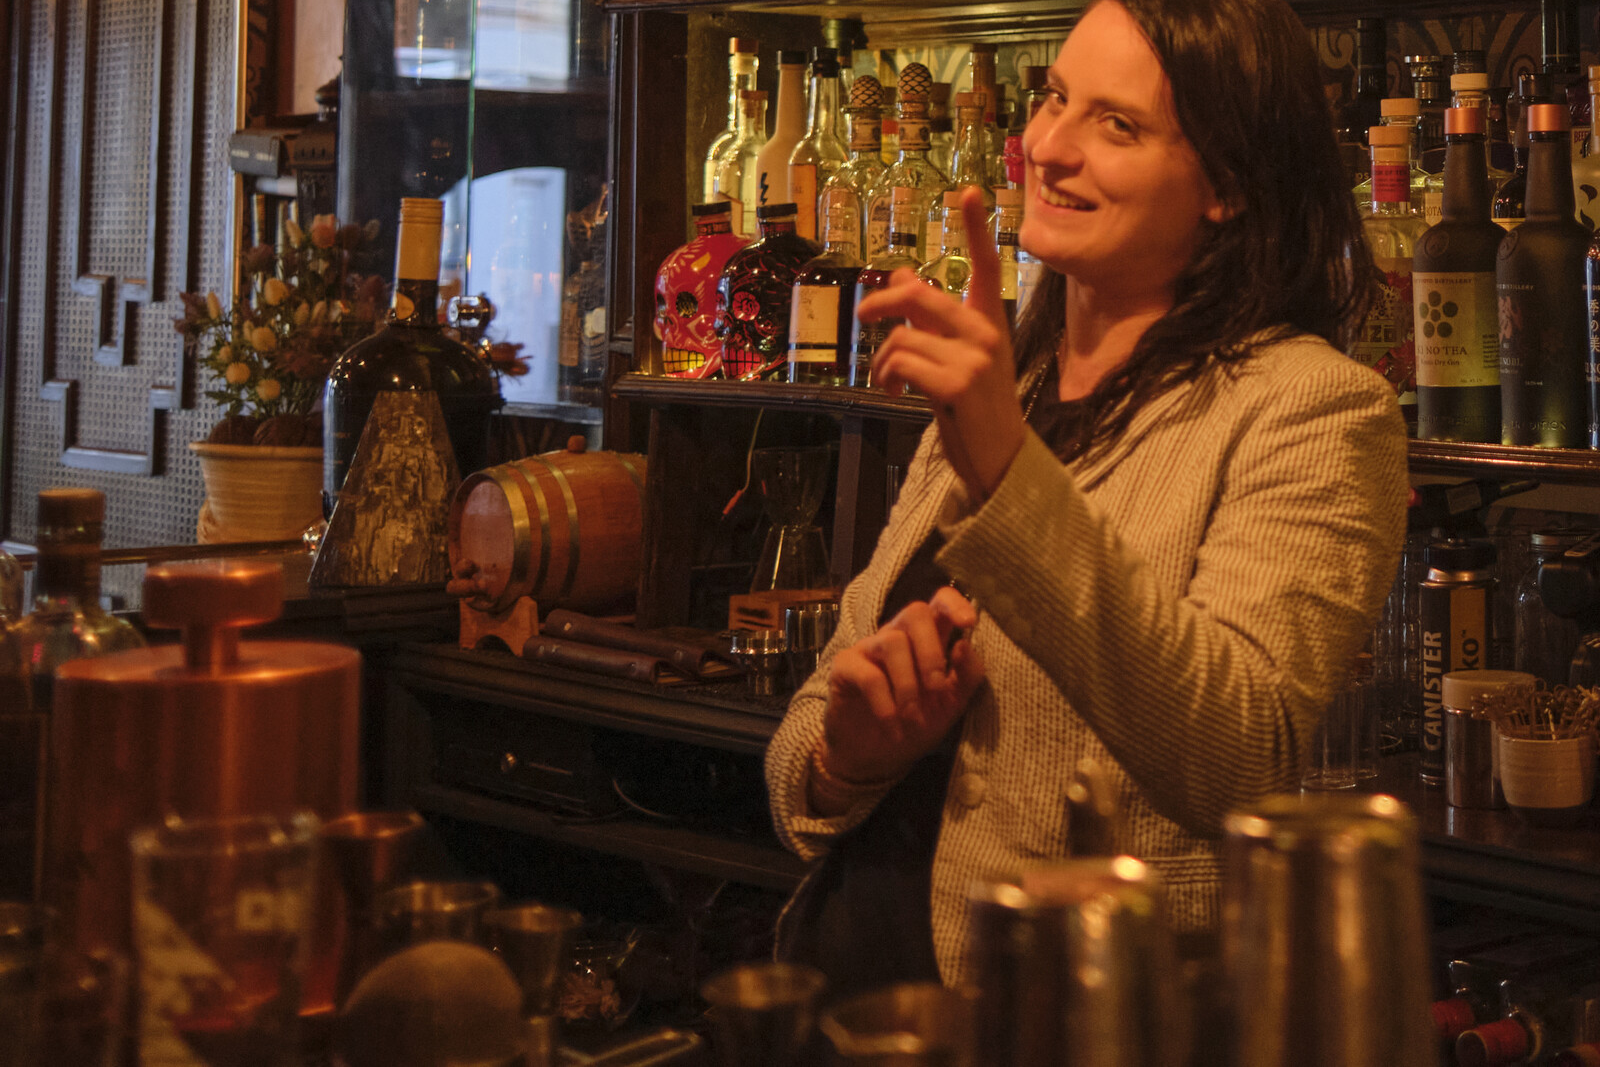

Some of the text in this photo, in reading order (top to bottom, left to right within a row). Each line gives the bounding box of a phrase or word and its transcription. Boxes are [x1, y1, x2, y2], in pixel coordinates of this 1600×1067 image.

[1426, 345, 1440, 355] NO
[1588, 298, 1600, 353] 季の美
[1423, 631, 1442, 752] CANISTER
